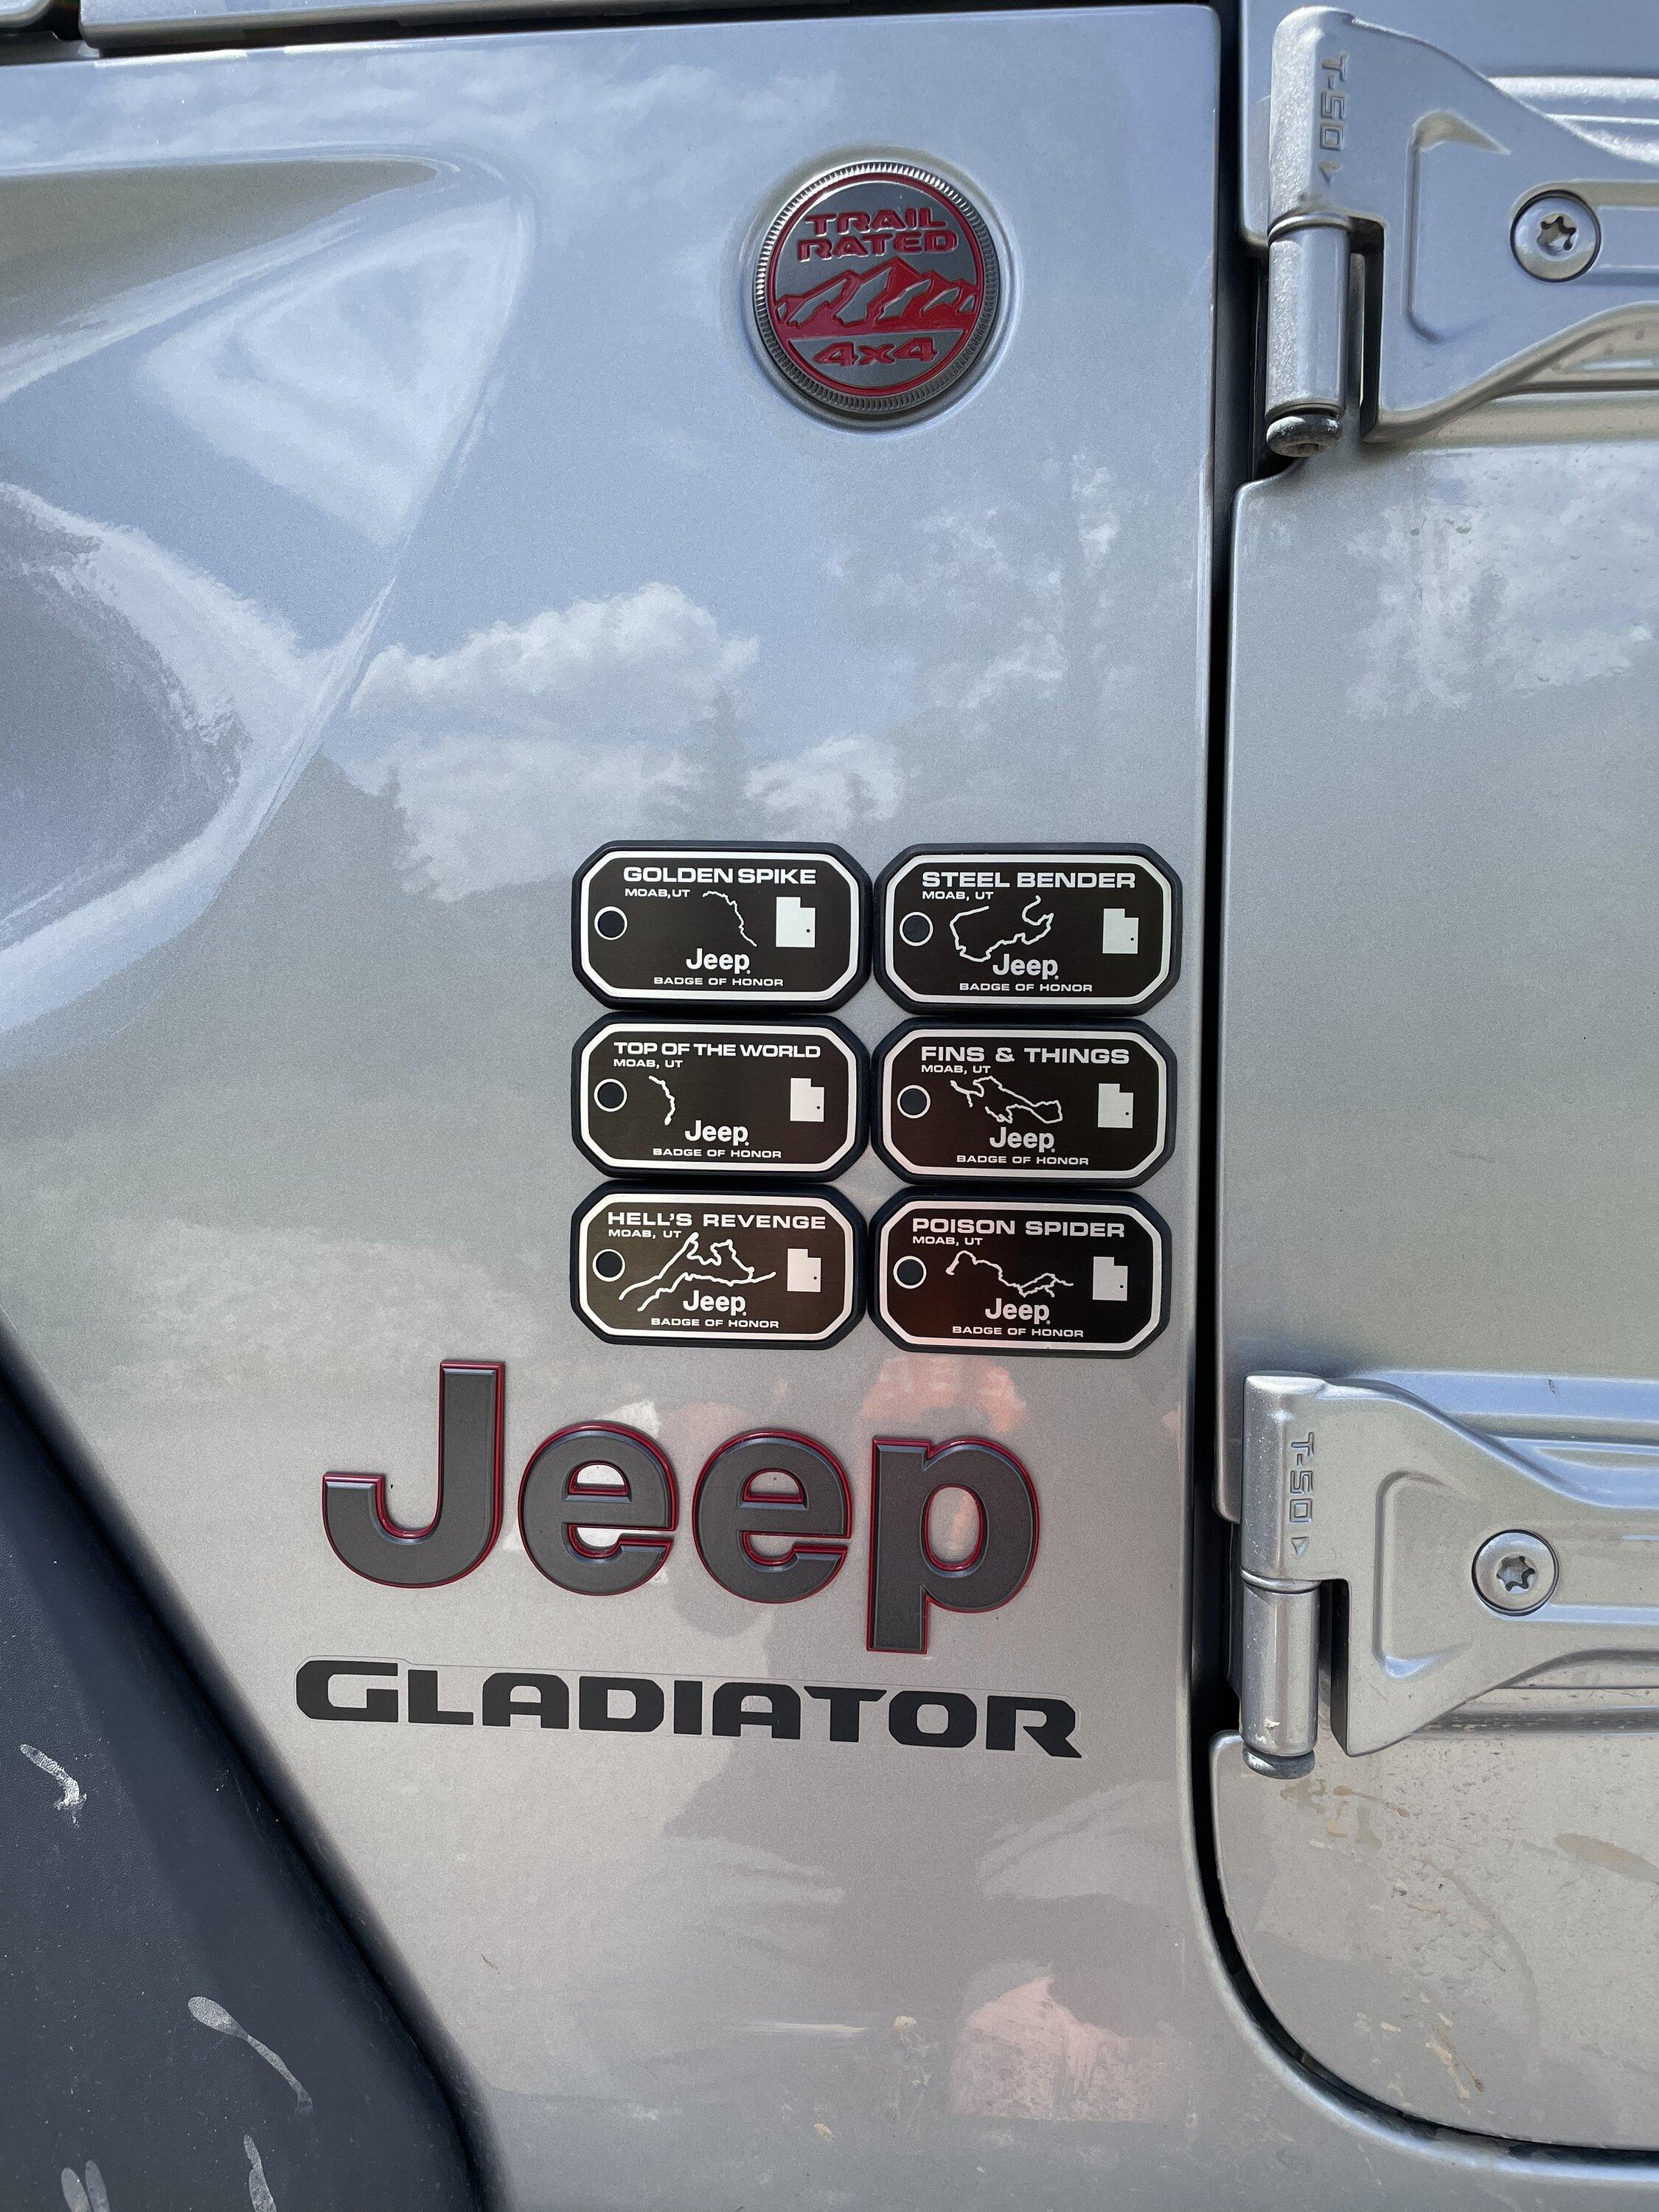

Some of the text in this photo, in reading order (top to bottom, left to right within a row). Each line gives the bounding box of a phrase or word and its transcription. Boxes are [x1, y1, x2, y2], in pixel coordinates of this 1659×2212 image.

[806, 208, 947, 237] TRAIL
[797, 230, 957, 262] RATED
[814, 338, 937, 366] 4x4
[624, 867, 816, 884] GOLDEN SPIKE
[922, 872, 1135, 888] STEEL BENDER
[922, 891, 993, 900] MOAB, UT
[686, 948, 750, 974] Jeep
[992, 953, 1059, 979] Jeep
[654, 977, 703, 985] BADGE
[732, 978, 783, 986] HONOR
[960, 983, 1092, 992] BADGE OF HONOR
[614, 1042, 821, 1058] TOP OF THE WORLD
[921, 1046, 1130, 1064] FINS & THINGS
[613, 1059, 659, 1068] MOAB,
[921, 1065, 990, 1074] MOAB, UT
[684, 1120, 749, 1146] Jeep
[990, 1127, 1055, 1152] Jeep
[653, 1148, 701, 1157] BADGE
[731, 1150, 782, 1158] HONOR
[957, 1155, 1006, 1164] BADGE
[1037, 1157, 1088, 1165] HONOR
[703, 1214, 826, 1229] REVENGE
[913, 1218, 1124, 1237] POISON SPIDER
[608, 1229, 655, 1239] MOAB,
[912, 1236, 982, 1246] MOAB, UT
[683, 1290, 746, 1316] Jeep
[985, 1298, 1050, 1324] Jeep
[651, 1318, 700, 1326] BADGE
[728, 1319, 779, 1328] HONOR
[953, 1326, 1083, 1338] BADGE OF HONOR
[321, 1360, 1040, 1653] Jeep
[295, 1659, 1082, 1759] GLADIATOR
